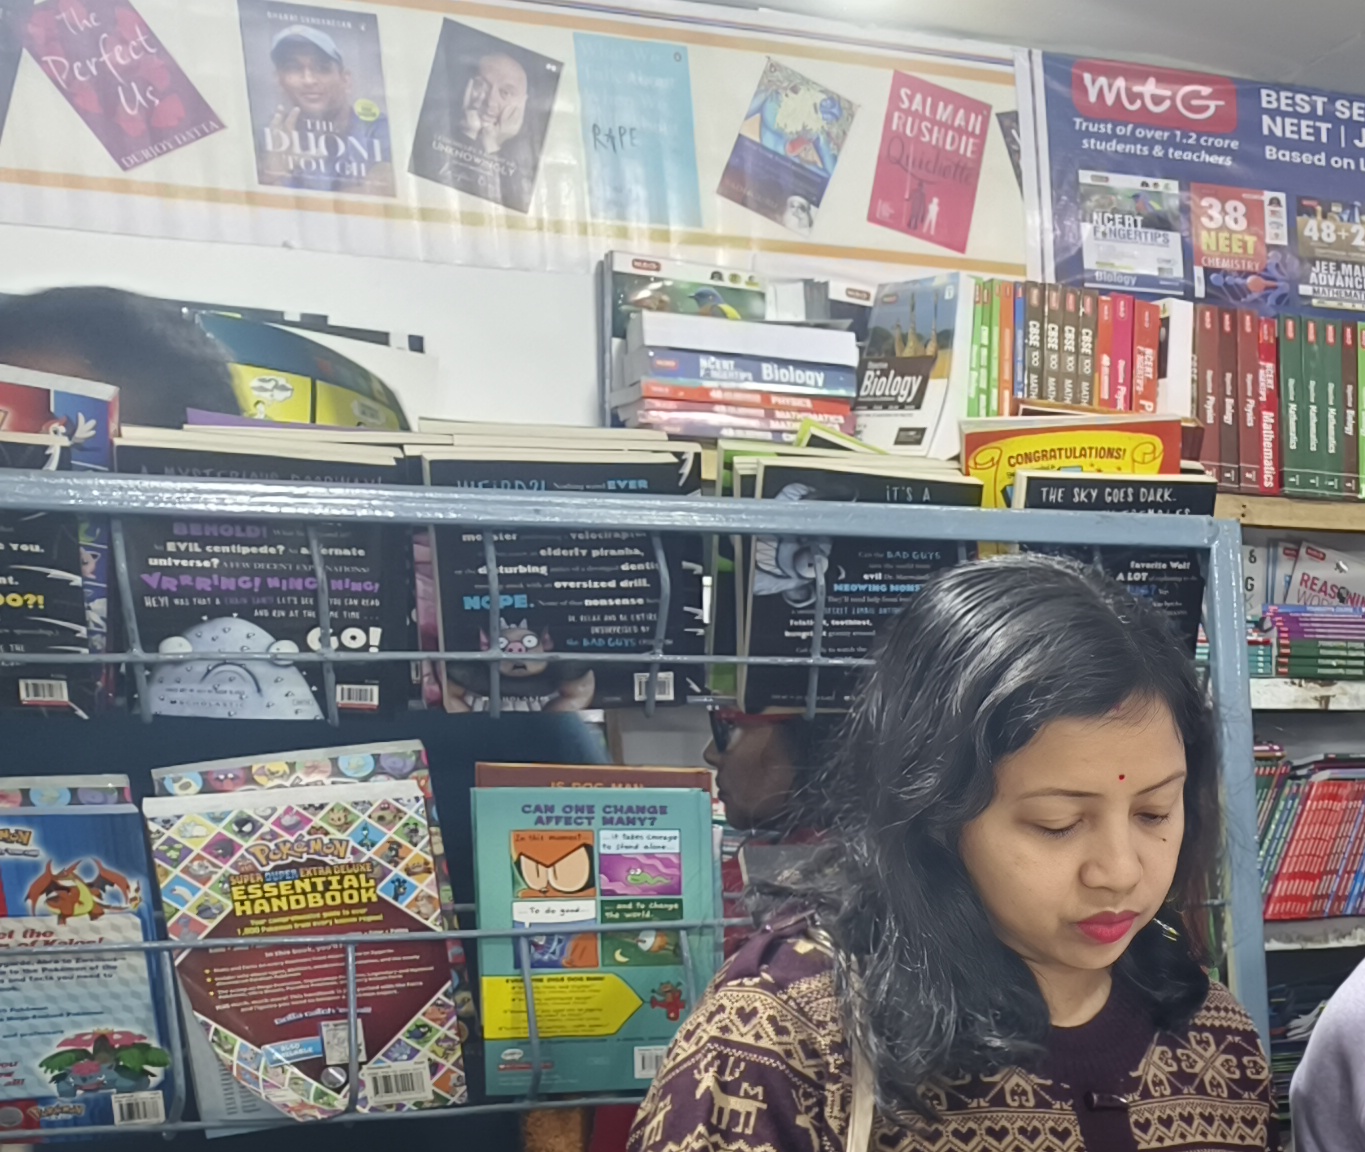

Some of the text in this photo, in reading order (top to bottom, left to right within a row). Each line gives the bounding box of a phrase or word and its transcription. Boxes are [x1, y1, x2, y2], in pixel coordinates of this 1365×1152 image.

[42, 26, 157, 91] Perfect
[117, 82, 160, 115] Us
[1261, 89, 1327, 116] BEST
[899, 87, 982, 135] SALMAN
[892, 112, 979, 158] RUSHDIE
[1073, 118, 1240, 150] Trust of over 1.2 crore
[1262, 116, 1331, 143] NEET
[1082, 137, 1232, 166] students & teachers
[1265, 145, 1327, 168] Based
[1331, 156, 1355, 171] on
[1093, 212, 1143, 228] NCERT
[1200, 198, 1248, 231] 38
[1202, 231, 1257, 255] NEET
[1201, 256, 1260, 272] CHEMISTRY
[1312, 261, 1338, 276] JEE
[1095, 271, 1138, 286] Biology
[762, 362, 824, 386] Biology
[860, 371, 922, 401] Biology
[1008, 447, 1126, 467] CONGRATULATIONS!
[1262, 411, 1274, 487] Mathematics
[607, 480, 648, 490] EVER
[922, 486, 931, 501] A
[1040, 487, 1176, 503] THE SKY GOES DARK.
[173, 522, 267, 538] BEHOLD!
[167, 542, 285, 556] EVIL centipede?
[540, 548, 645, 558] elderly piranha,
[912, 551, 941, 560] GUYS
[148, 557, 220, 569] universe?
[554, 580, 617, 588] oversized
[833, 583, 887, 593] MEOWING
[584, 599, 645, 607] nonsense
[521, 804, 668, 816] CAN ONE CHANGE
[534, 815, 657, 826] AFFECT MANY?
[230, 862, 373, 884] SUPER DUPER EXTRA DELUXE
[232, 873, 375, 900] ESSENTIAL
[234, 888, 378, 916] HANDBOOK
